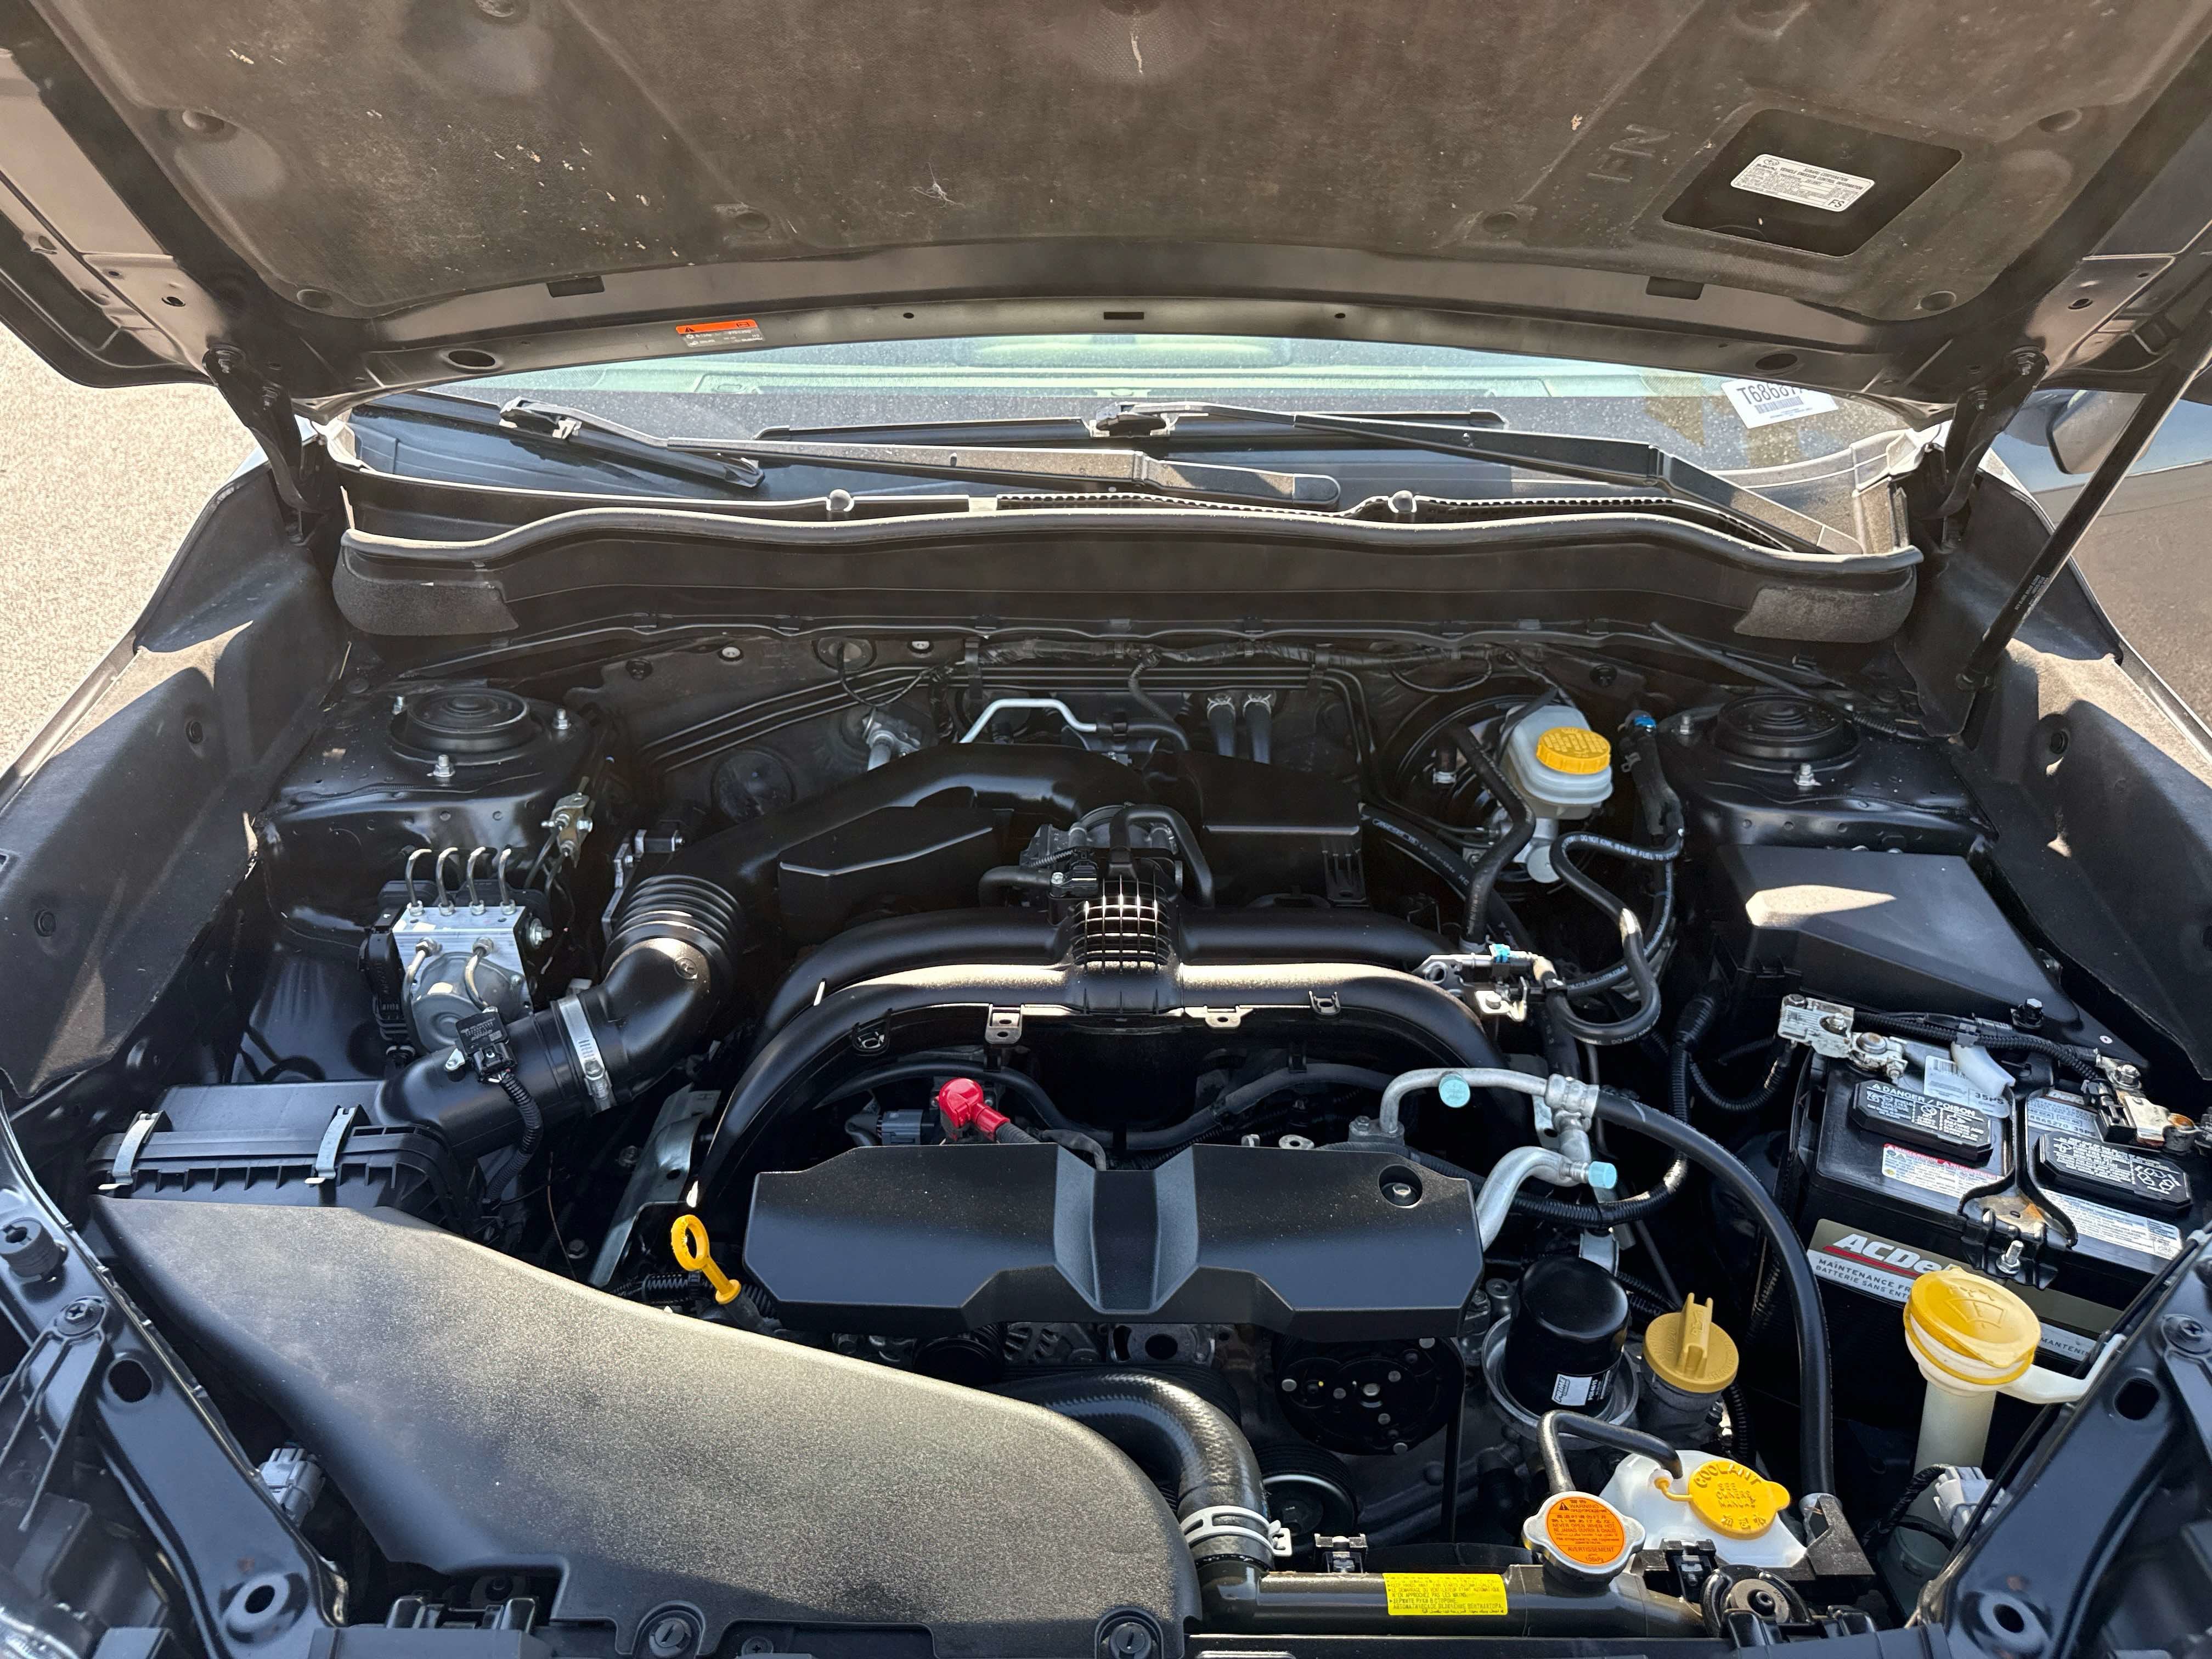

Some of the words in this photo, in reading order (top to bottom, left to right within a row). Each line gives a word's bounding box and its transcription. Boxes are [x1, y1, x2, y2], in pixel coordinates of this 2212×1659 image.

[1828, 199, 1844, 208] FS
[1882, 1086, 1925, 1103] DANGER
[1936, 1100, 1976, 1116] POISON
[1833, 1233, 1952, 1274] ACDe
[1815, 1265, 1859, 1284] BATTERIE
[1862, 1280, 1886, 1293] SANS
[1818, 1258, 1895, 1288] MAINTENANCE
[1554, 1375, 1567, 1402] PRIME
[1694, 1464, 1762, 1488] COOLANT
